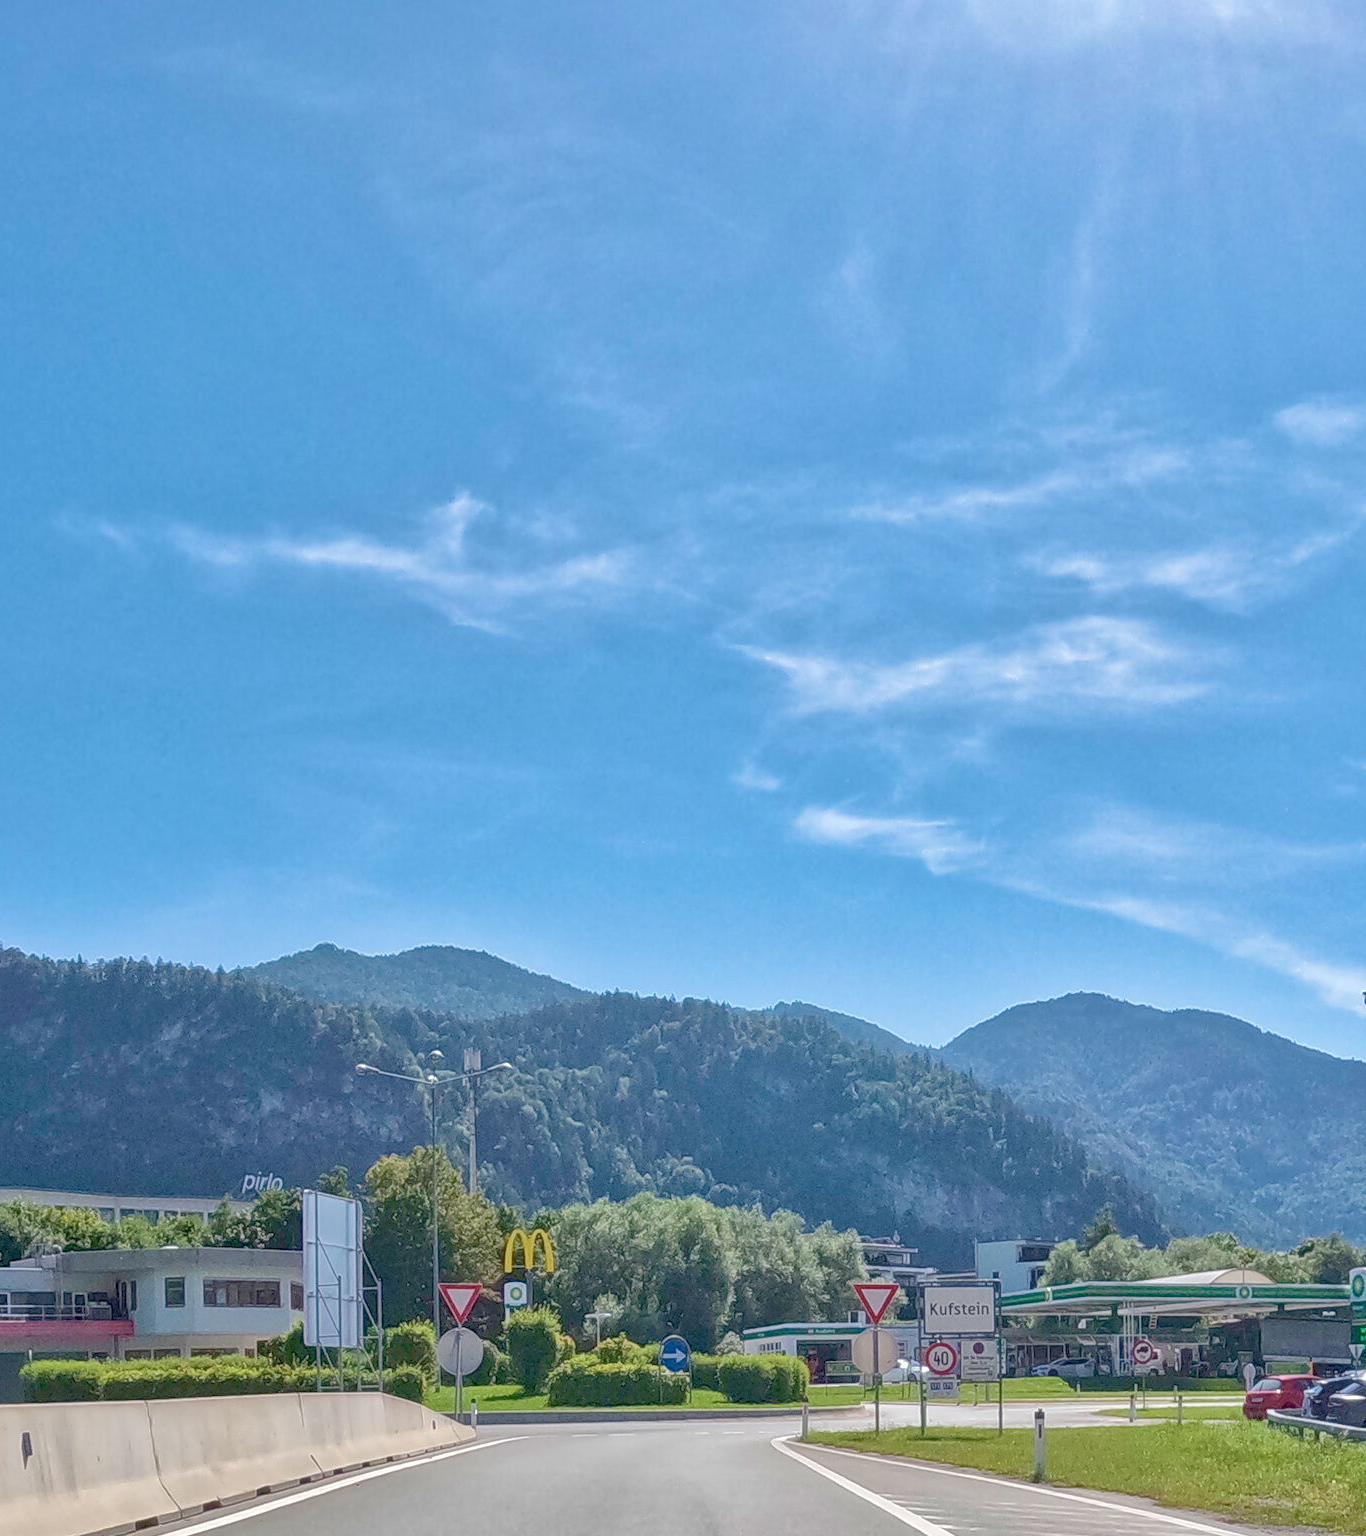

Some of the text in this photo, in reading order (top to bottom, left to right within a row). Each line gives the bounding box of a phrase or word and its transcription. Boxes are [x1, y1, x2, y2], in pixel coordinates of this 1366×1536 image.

[241, 1171, 283, 1194] pirlo
[930, 1302, 990, 1316] Kufstein
[933, 1351, 949, 1366] 40
